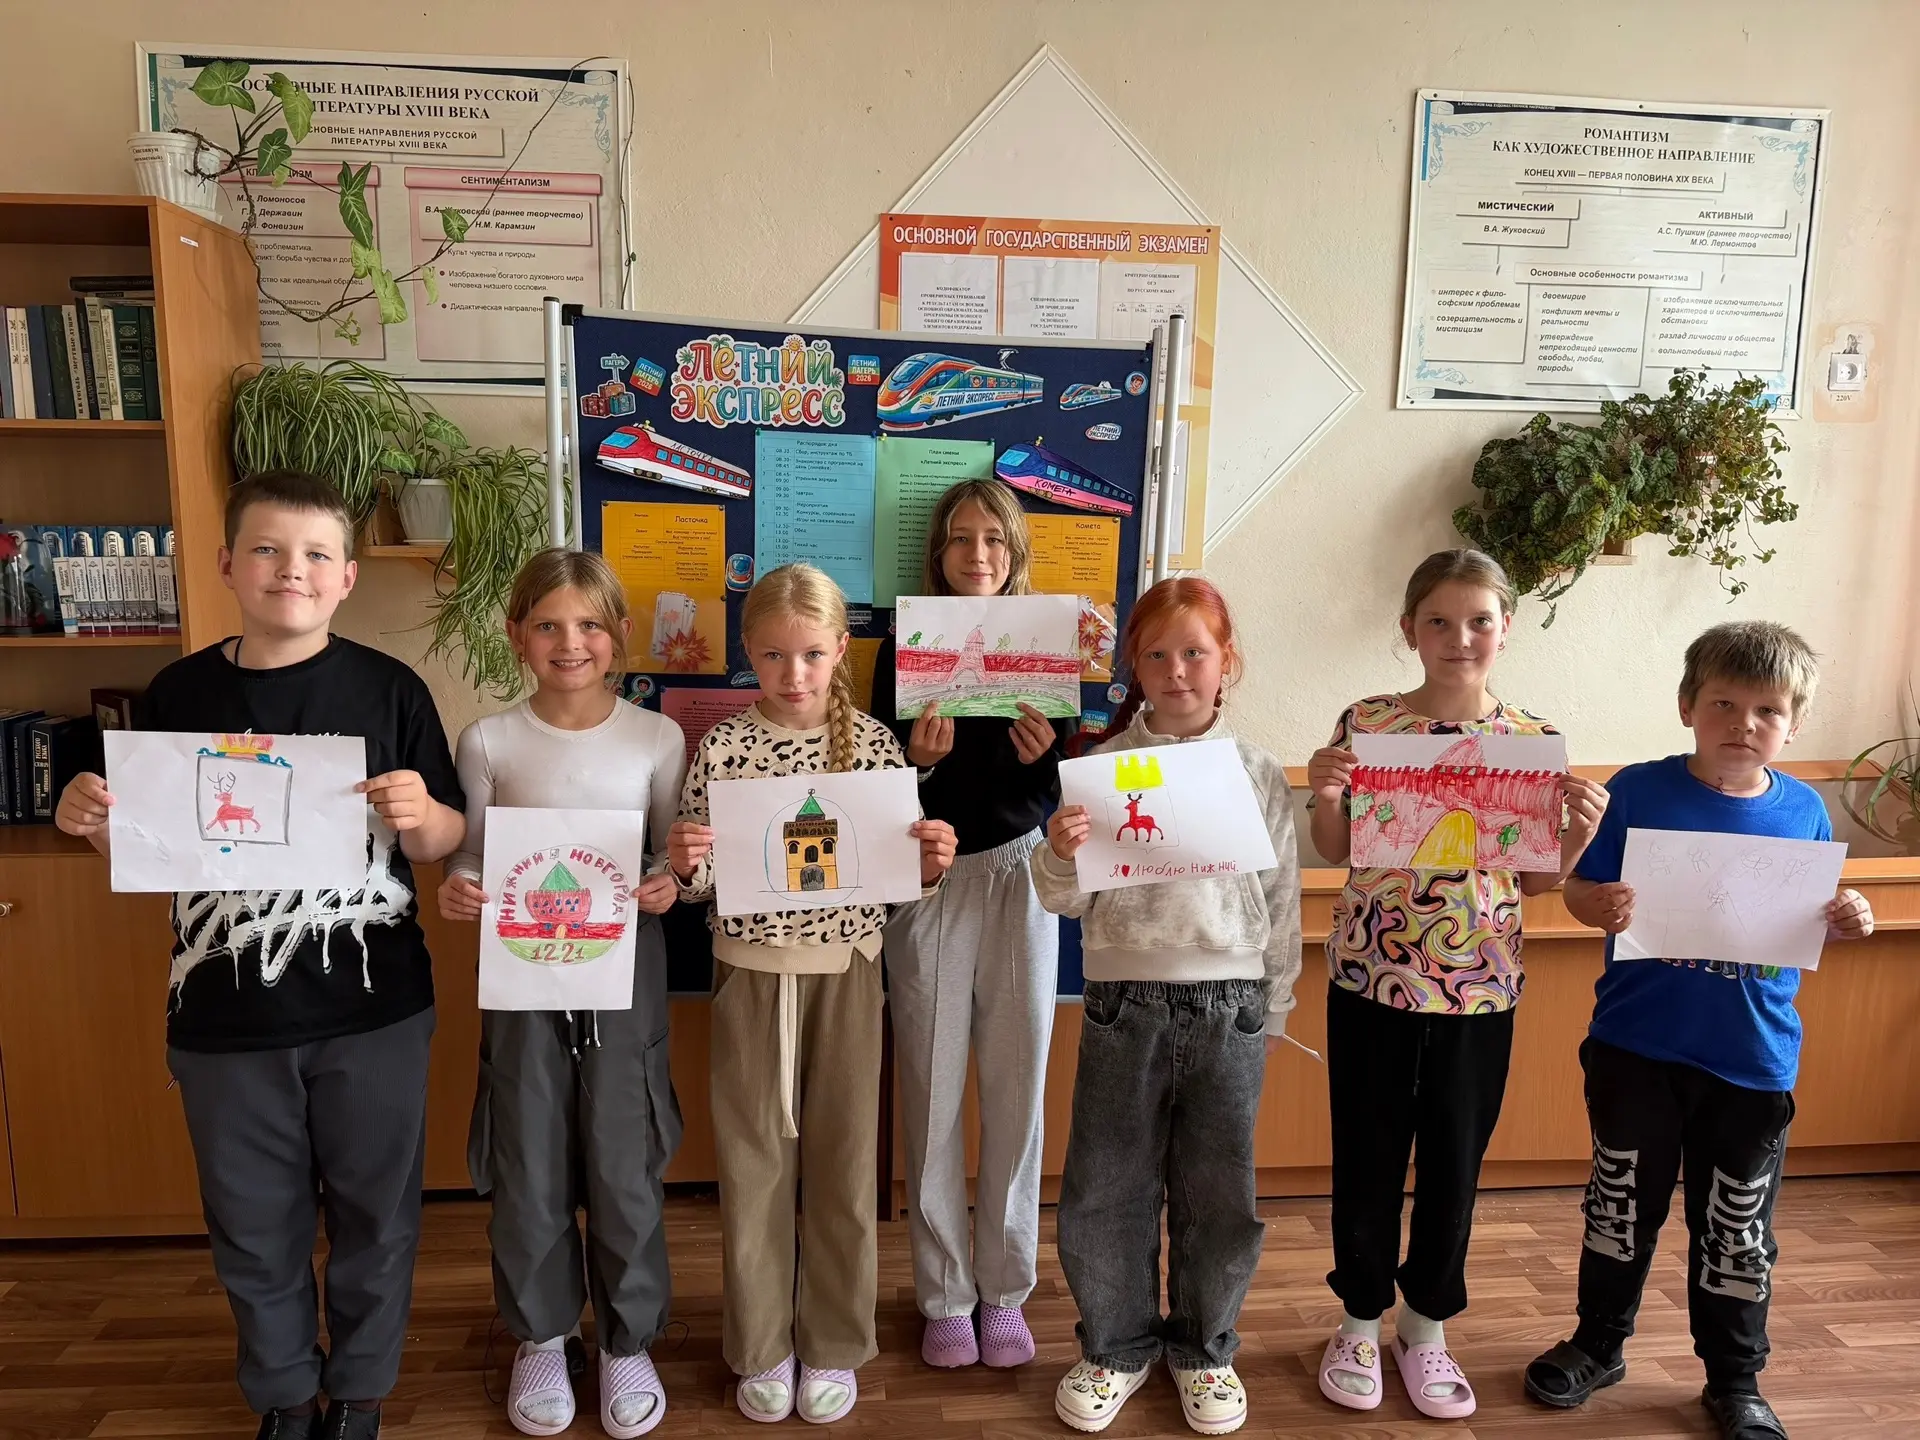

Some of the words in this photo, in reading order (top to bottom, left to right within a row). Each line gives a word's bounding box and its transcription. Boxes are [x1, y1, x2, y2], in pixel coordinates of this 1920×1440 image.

[241, 78, 337, 95] ОСВНЫЕ
[341, 82, 459, 100] НАПРАВЛЕНИЯ
[464, 85, 539, 103] РУССКОЙ
[313, 101, 400, 117] ТЕРАТУРЫ
[405, 104, 444, 118] XVIII
[449, 106, 490, 120] ВЕКА
[307, 126, 356, 135] СНОВНЫЕ
[358, 127, 431, 138] НАПРАВЛЕНИЯ
[433, 129, 478, 140] РУССКОЙ
[1584, 127, 1669, 143] РОМАНТИЗМ
[330, 137, 396, 148] ЛИТЕРАТУРЫ
[398, 139, 420, 149] XVIII
[423, 140, 448, 150] ВЕКА
[1492, 140, 1520, 153] КАК
[1524, 142, 1655, 159] ХУДОЖЕСТВЕННОЕ
[1658, 150, 1756, 164] НАПРАВЛЕНИЕ
[461, 175, 551, 187] СЕНТИМЕНТАЛИЗМ
[1524, 168, 1555, 179] КОНЕЦ
[1557, 169, 1576, 178] XVIII
[1588, 171, 1623, 180] ПЕРВАЯ
[1625, 172, 1674, 183] ПОЛОВИНА
[1676, 174, 1690, 184] XIX
[1692, 175, 1714, 184] ВЕКА
[257, 196, 306, 204] Ломоносов
[1478, 201, 1555, 212] МИСТИЧЕСКИЙ
[258, 209, 303, 218] Державин
[492, 208, 525, 218] (раннее
[526, 210, 584, 220] творчество)
[1699, 210, 1754, 221] АКТИВНЫЙ
[261, 222, 304, 231] Фонвизин
[475, 221, 493, 229] Н.М.
[495, 222, 536, 231] Карамзин
[1484, 225, 1500, 233] В.А.
[1501, 225, 1546, 235] Жуковский
[1674, 228, 1705, 237] Пушкин
[1706, 229, 1737, 239] (раннее
[1738, 231, 1792, 241] творчество)
[893, 226, 978, 247] ОСНОВНОЙ
[985, 228, 1132, 253] ГОСУДАРСТВЕННЫЙ
[1138, 234, 1209, 255] ЭКЗАМЕН
[1710, 240, 1757, 249] Лермонтов
[276, 254, 302, 262] борьба
[303, 256, 332, 264] чувства
[470, 250, 497, 258] чувства
[504, 251, 536, 259] природы
[449, 270, 496, 279] Изображение
[497, 272, 528, 280] богатого
[529, 274, 565, 282] духовного
[1530, 268, 1576, 278] Основные
[1578, 270, 1636, 279] особенности
[1638, 272, 1689, 282] романтизма
[292, 277, 332, 285] идеальный
[483, 283, 513, 291] низшего
[1438, 289, 1475, 297] интерес
[1482, 289, 1507, 298] фило-
[1542, 292, 1587, 301] двоемирие
[1437, 299, 1474, 308] софским
[1475, 300, 1521, 309] проблемам
[1663, 295, 1713, 305] изображение
[1714, 297, 1784, 308] исключительных
[450, 303, 501, 312] Дидактическая
[1541, 307, 1582, 316] конфликт
[1584, 308, 1613, 317] мечты
[1662, 307, 1708, 317] характеров
[1716, 308, 1784, 318] исключительной
[1436, 315, 1516, 325] созерцательность
[1540, 318, 1590, 327] реальности
[1661, 316, 1709, 325] обстановки
[1436, 325, 1483, 334] мистицизм
[1539, 332, 1594, 343] утверждение
[1658, 331, 1687, 342] разлад
[1688, 333, 1727, 342] личности
[1734, 334, 1776, 343] общества
[1539, 343, 1597, 353] непреходящей
[1598, 345, 1638, 354] ценности
[1658, 346, 1722, 357] вольнолюбивый
[1723, 348, 1749, 358] пафос
[851, 358, 877, 368] ЛЕТНИЙ
[1538, 353, 1575, 363] свободы,
[1577, 354, 1605, 364] любви,
[639, 362, 664, 378] ЛЕТНИЙ
[851, 367, 877, 375] ЛАГЕРЬ
[1537, 363, 1574, 373] природы
[636, 370, 659, 385] ЛАГЕРЬ
[936, 391, 965, 407] ЛЕТНИЙ
[965, 392, 996, 404] ЭКСПРЕСС
[671, 384, 844, 426] ЭКСПРЕСС
[1034, 478, 1076, 496] КОМЕТА
[675, 515, 708, 524] Ласточка
[1075, 522, 1101, 530] Комета
[1084, 712, 1107, 721] ЛЕТНИЙ
[1083, 719, 1105, 728] ЛАГЕРЬ
[1109, 864, 1119, 878] Я
[499, 851, 544, 921] НИЖНИЙ
[569, 848, 630, 916] НОВГОРОД
[530, 942, 585, 963] 1221
